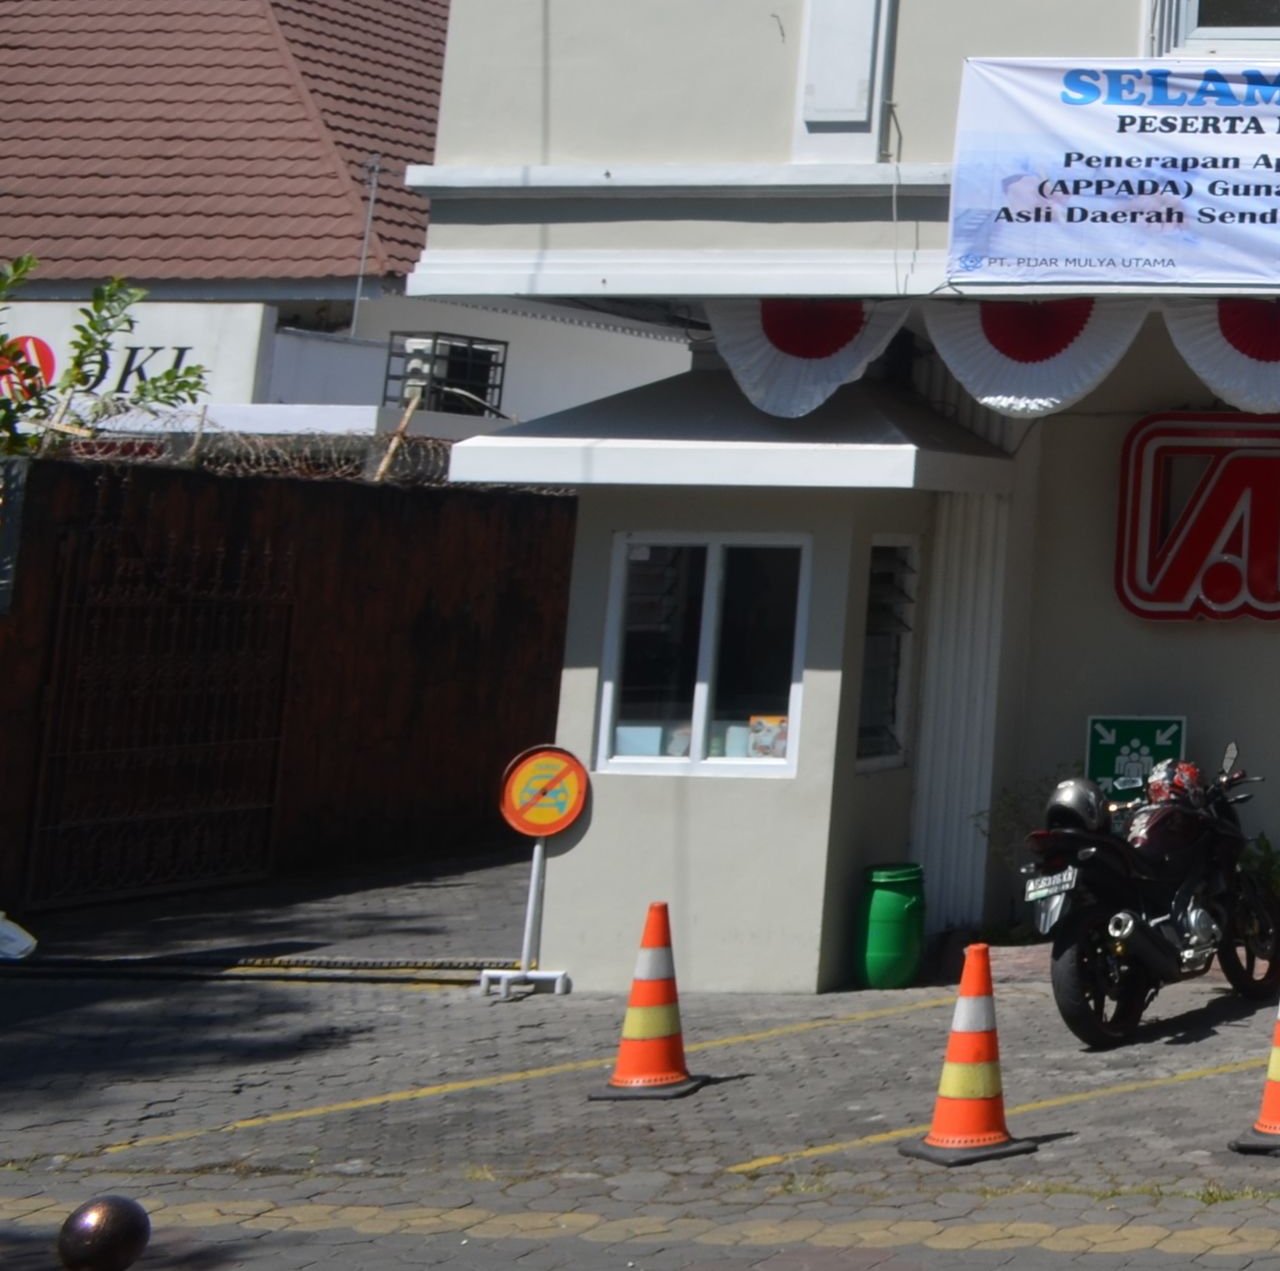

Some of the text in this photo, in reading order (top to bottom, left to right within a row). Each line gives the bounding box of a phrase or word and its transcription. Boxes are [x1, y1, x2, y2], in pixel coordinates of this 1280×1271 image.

[1116, 115, 1265, 135] PESERTA
[1063, 152, 1240, 172] Penerapan
[1038, 179, 1194, 200] (APPADA)
[994, 206, 1052, 223] Asli
[1066, 206, 1185, 224] Daerah
[988, 257, 1176, 268] PT. PIJAR MULYA UTAMA
